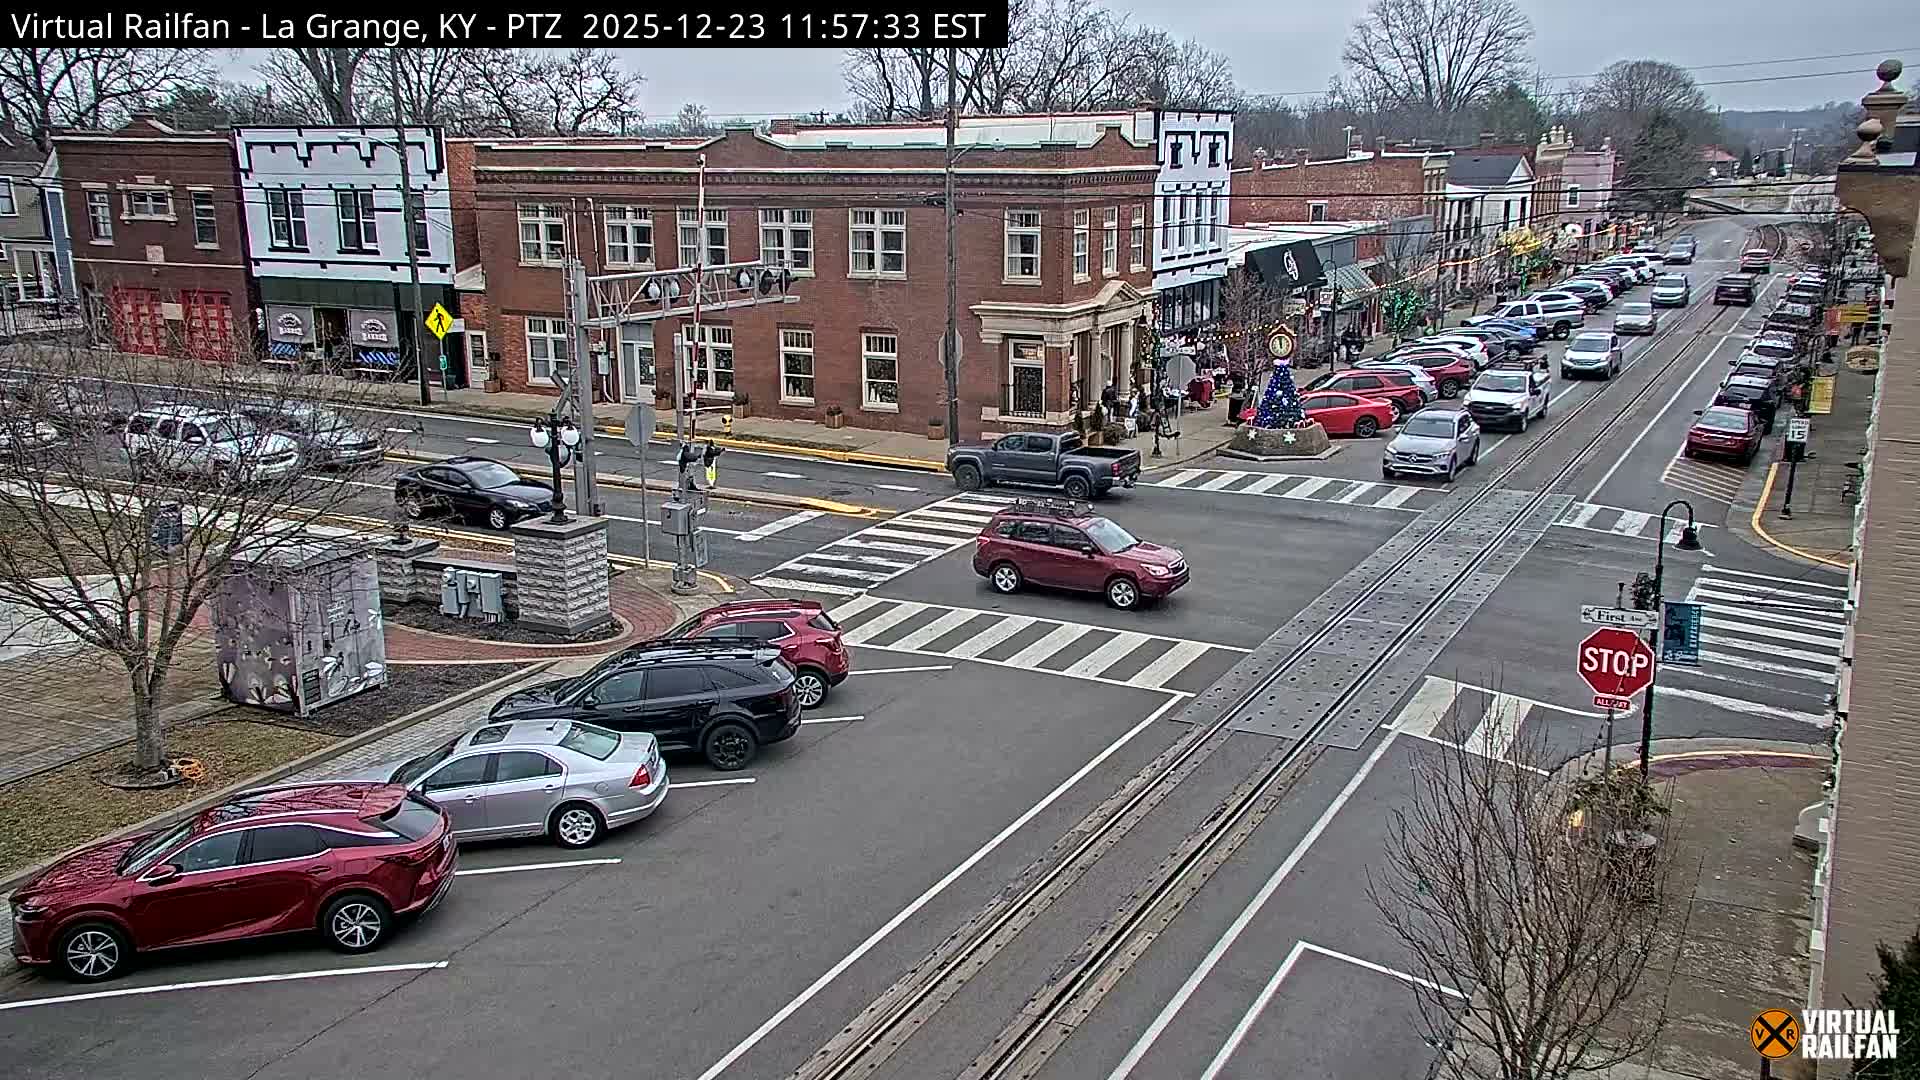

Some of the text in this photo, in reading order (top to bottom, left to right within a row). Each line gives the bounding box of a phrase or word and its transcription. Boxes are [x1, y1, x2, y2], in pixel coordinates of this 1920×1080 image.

[1791, 430, 1806, 440] 15
[1597, 610, 1625, 622] First
[1583, 646, 1649, 678] STOP
[1596, 698, 1609, 706] ALL
